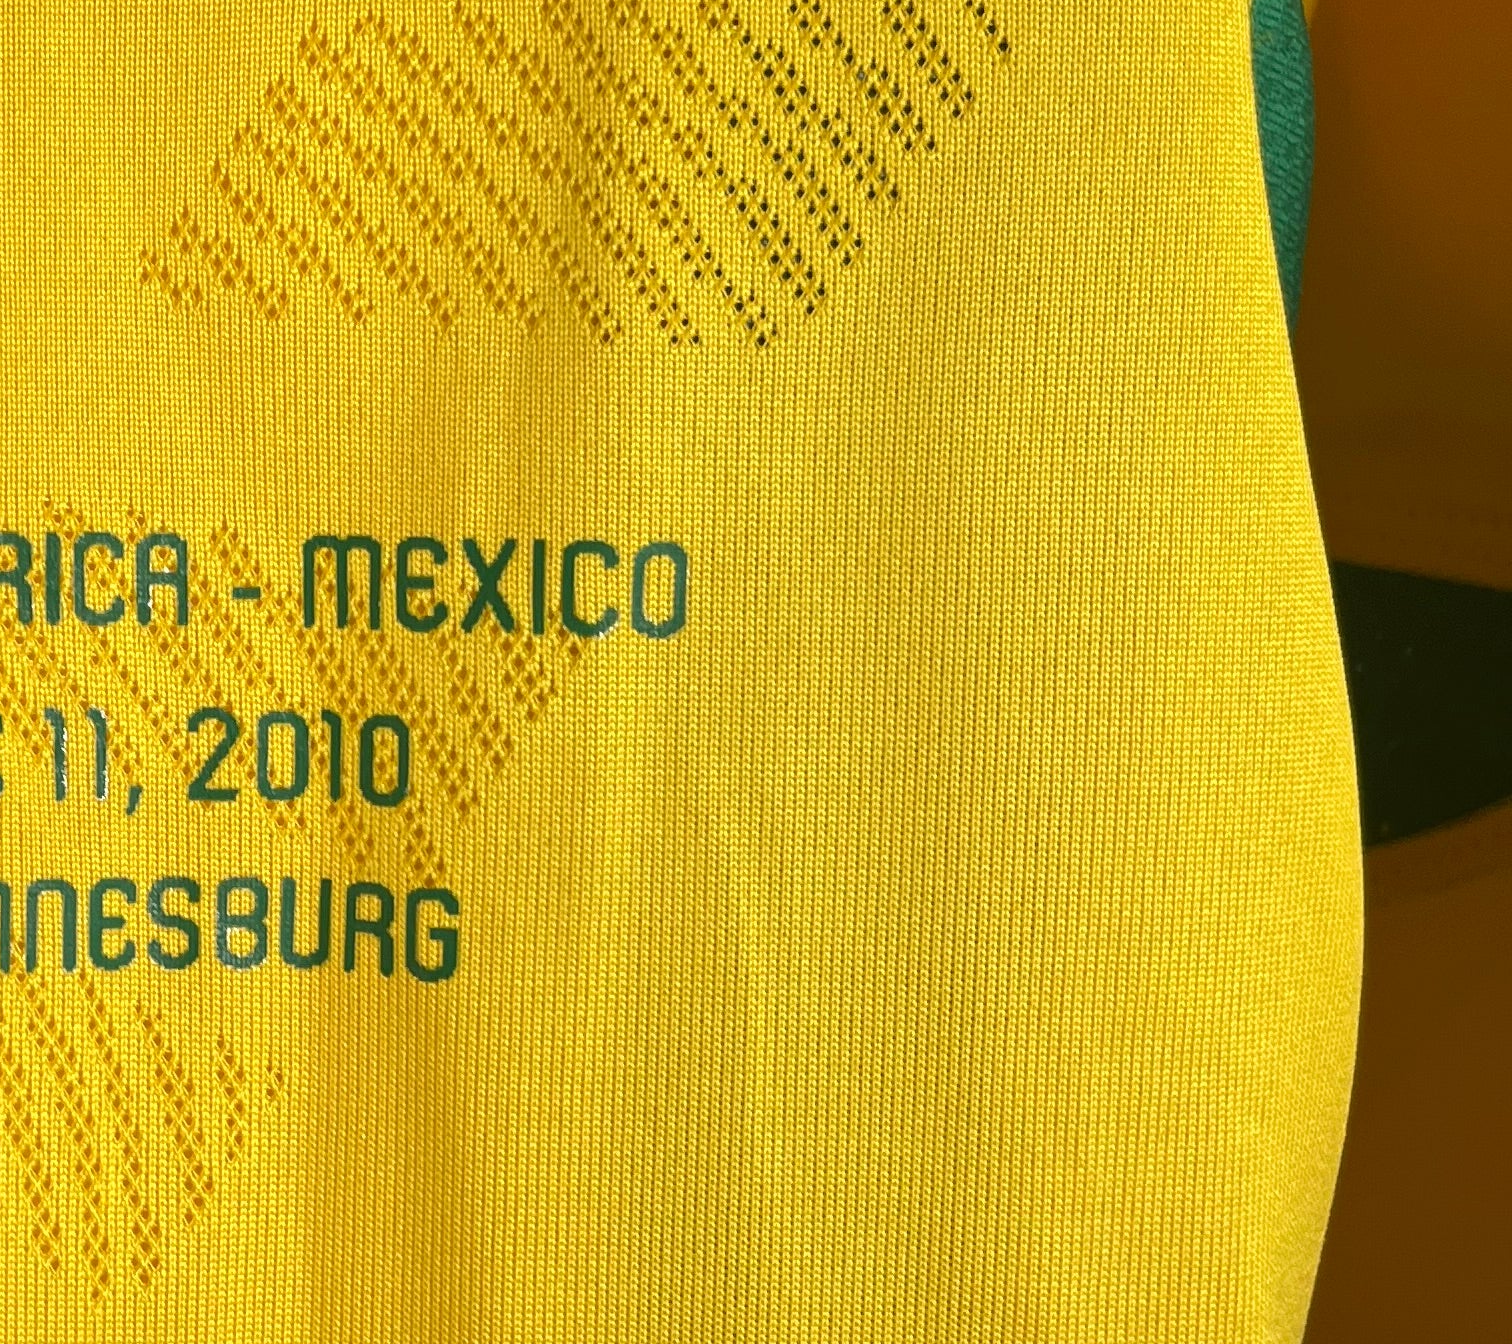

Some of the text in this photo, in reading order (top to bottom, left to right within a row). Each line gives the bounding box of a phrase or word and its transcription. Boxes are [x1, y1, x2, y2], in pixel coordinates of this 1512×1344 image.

[231, 586, 262, 600] -
[302, 535, 688, 639] MEXICO
[44, 707, 143, 816] 11,
[187, 708, 410, 807] 2010
